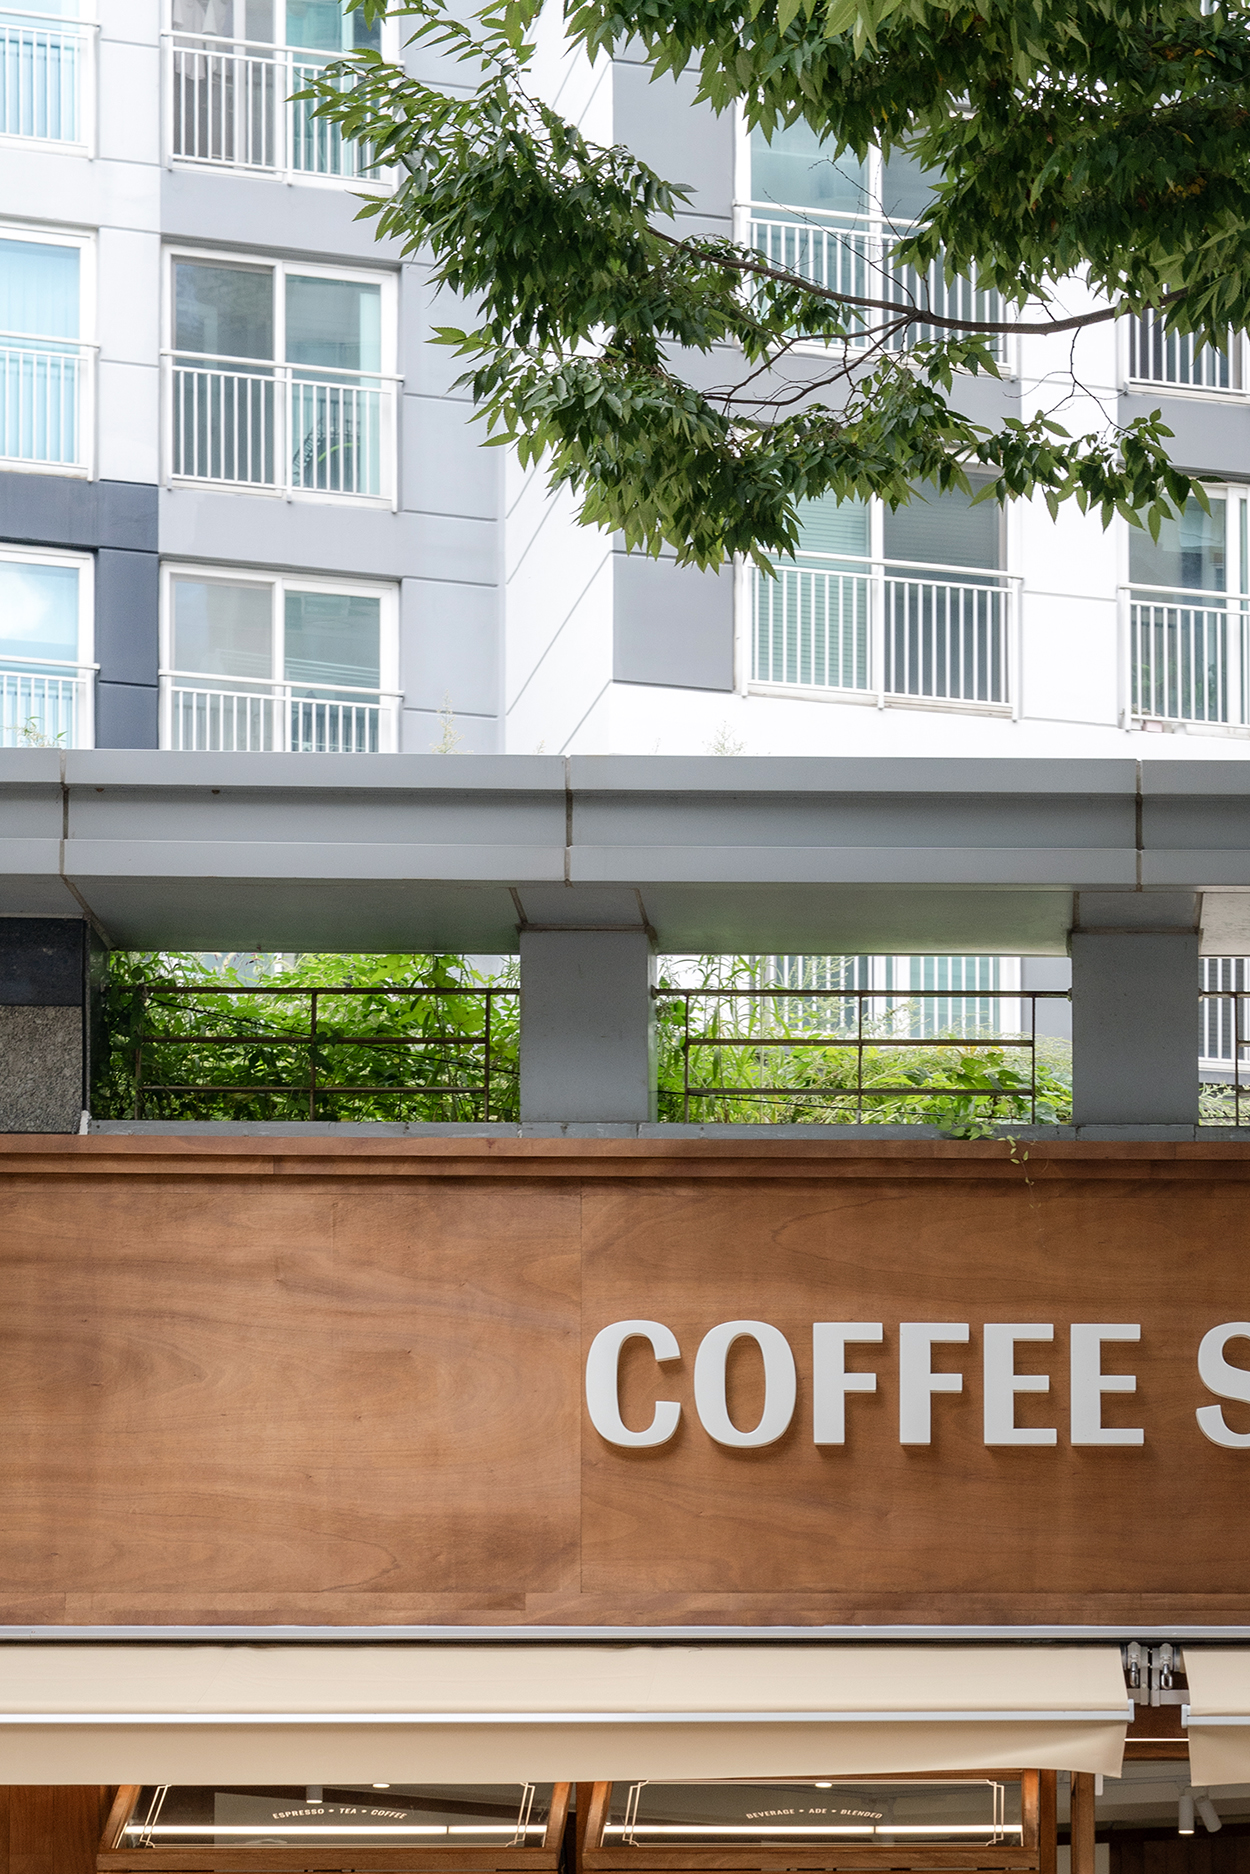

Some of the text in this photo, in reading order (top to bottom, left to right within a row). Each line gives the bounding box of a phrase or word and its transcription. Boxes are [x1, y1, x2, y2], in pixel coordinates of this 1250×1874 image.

[585, 1319, 1143, 1447] COFFEE
[272, 1808, 325, 1820] ESPRESSO
[370, 1809, 408, 1820] COFFEE
[745, 1809, 795, 1819] BEVERAGE
[840, 1809, 883, 1819] BLENDED
